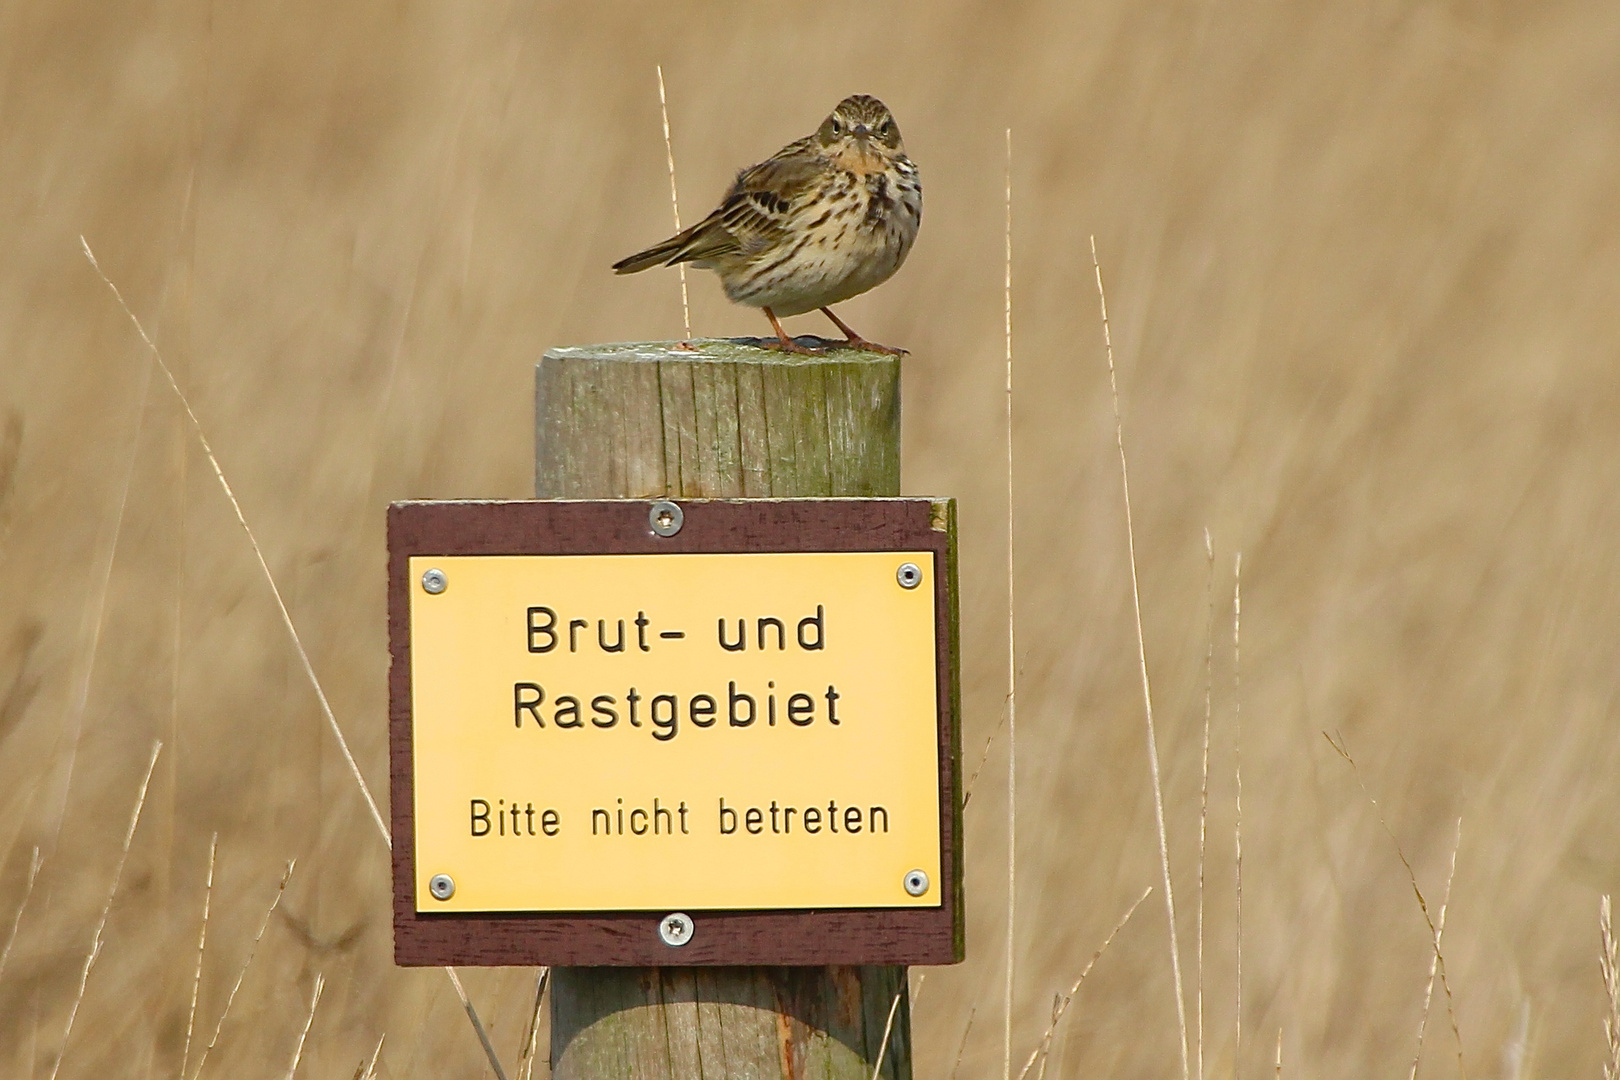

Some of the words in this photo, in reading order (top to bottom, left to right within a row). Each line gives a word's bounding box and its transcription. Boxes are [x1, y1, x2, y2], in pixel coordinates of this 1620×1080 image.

[527, 606, 685, 654] Brut-
[718, 604, 825, 652] und
[514, 681, 842, 741] Rastgebiet
[470, 799, 560, 837] Bitte
[592, 797, 690, 836] nicht
[719, 797, 889, 835] betreten
